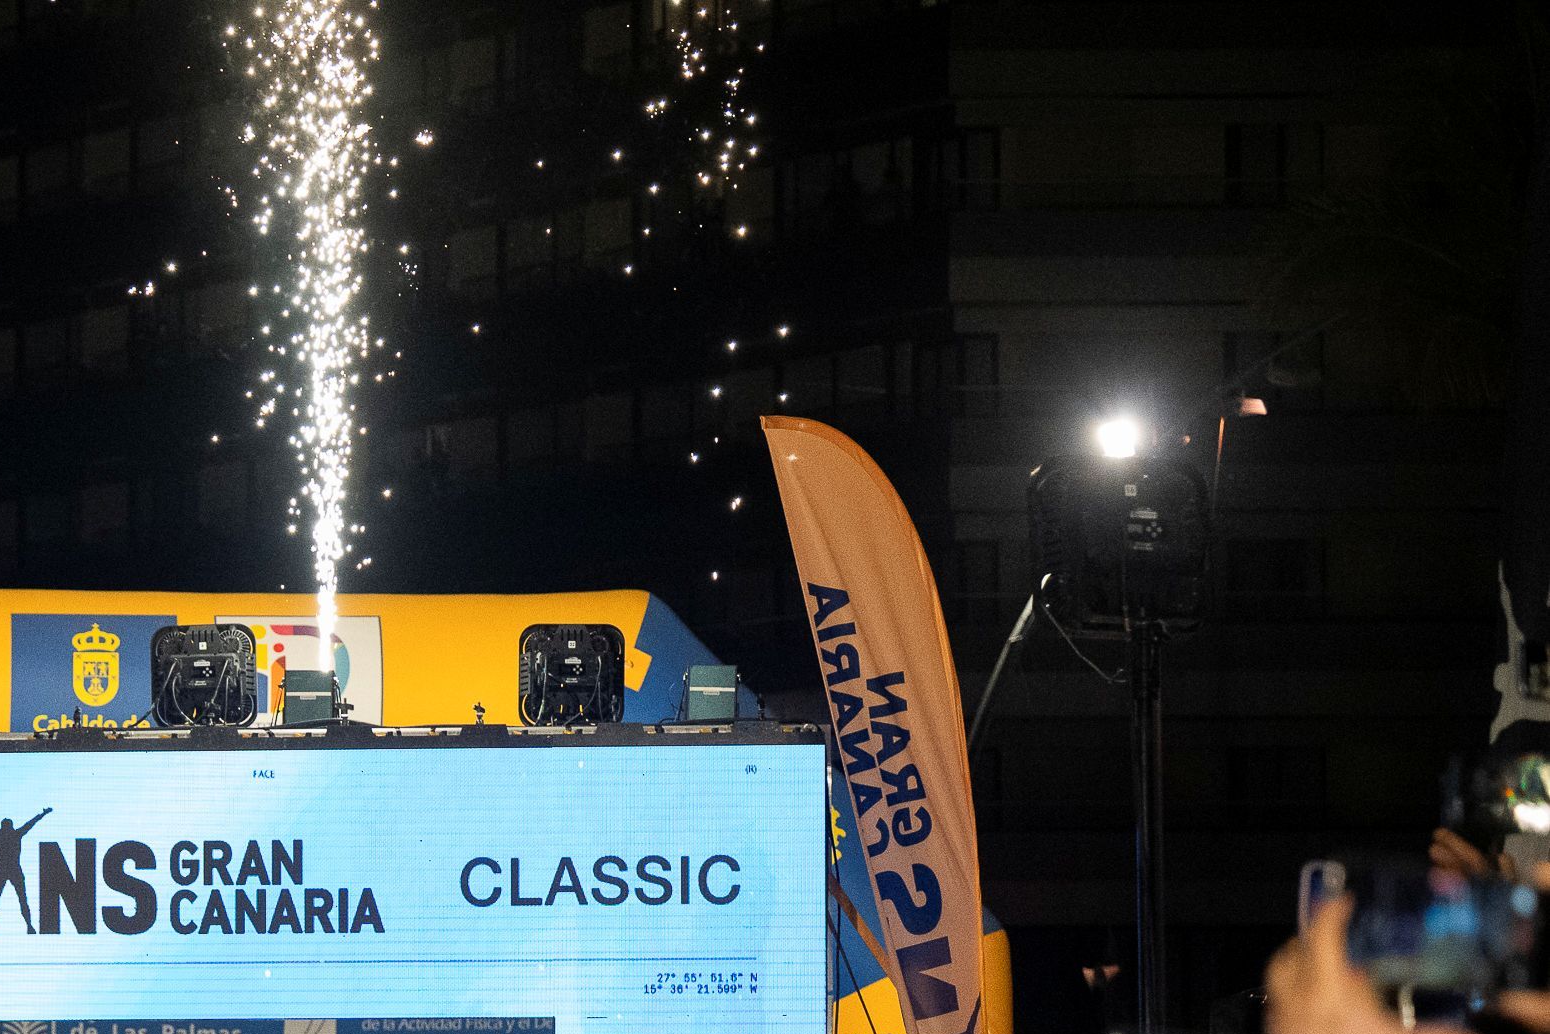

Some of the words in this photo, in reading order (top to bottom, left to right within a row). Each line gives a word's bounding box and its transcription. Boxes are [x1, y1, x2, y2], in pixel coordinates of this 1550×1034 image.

[169, 839, 304, 887] GRAN
[459, 854, 742, 908] CLASSIC
[169, 888, 386, 935] CANARIA
[750, 973, 758, 983] N
